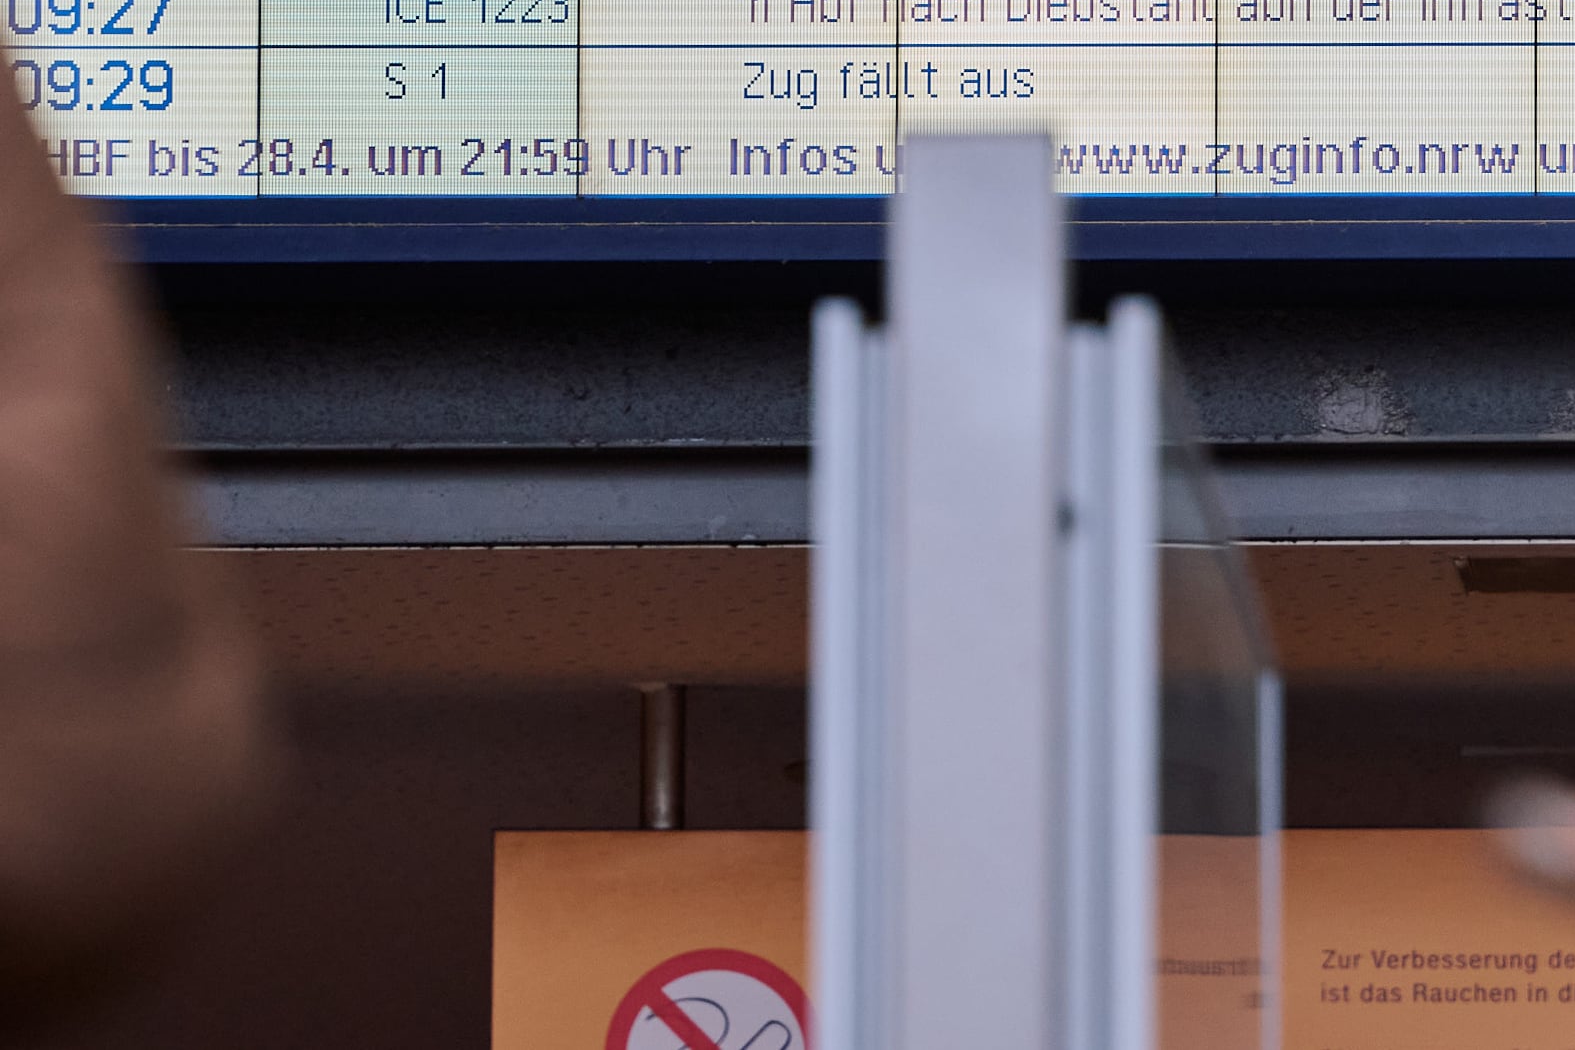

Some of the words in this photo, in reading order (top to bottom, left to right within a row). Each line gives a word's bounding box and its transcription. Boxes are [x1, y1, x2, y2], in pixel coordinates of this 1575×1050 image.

[11, 60, 173, 110] 09:29
[385, 63, 407, 100] S
[432, 63, 447, 100] 1
[743, 61, 818, 110] Zug
[840, 61, 938, 99] fällt
[960, 68, 1035, 99] aus
[41, 140, 132, 176] HBF
[149, 140, 219, 176] bis
[237, 140, 350, 177] 28.4.
[369, 145, 441, 176] um
[460, 139, 588, 177] 21:59
[607, 138, 688, 176] Uhr
[730, 138, 858, 176] Infos
[1321, 949, 1360, 969] Zur
[1371, 949, 1536, 973] Verbesserung
[1321, 984, 1350, 1002] ist
[1360, 984, 1401, 1002] das
[1412, 983, 1517, 1002] Rauchen
[1527, 983, 1548, 1002] in
